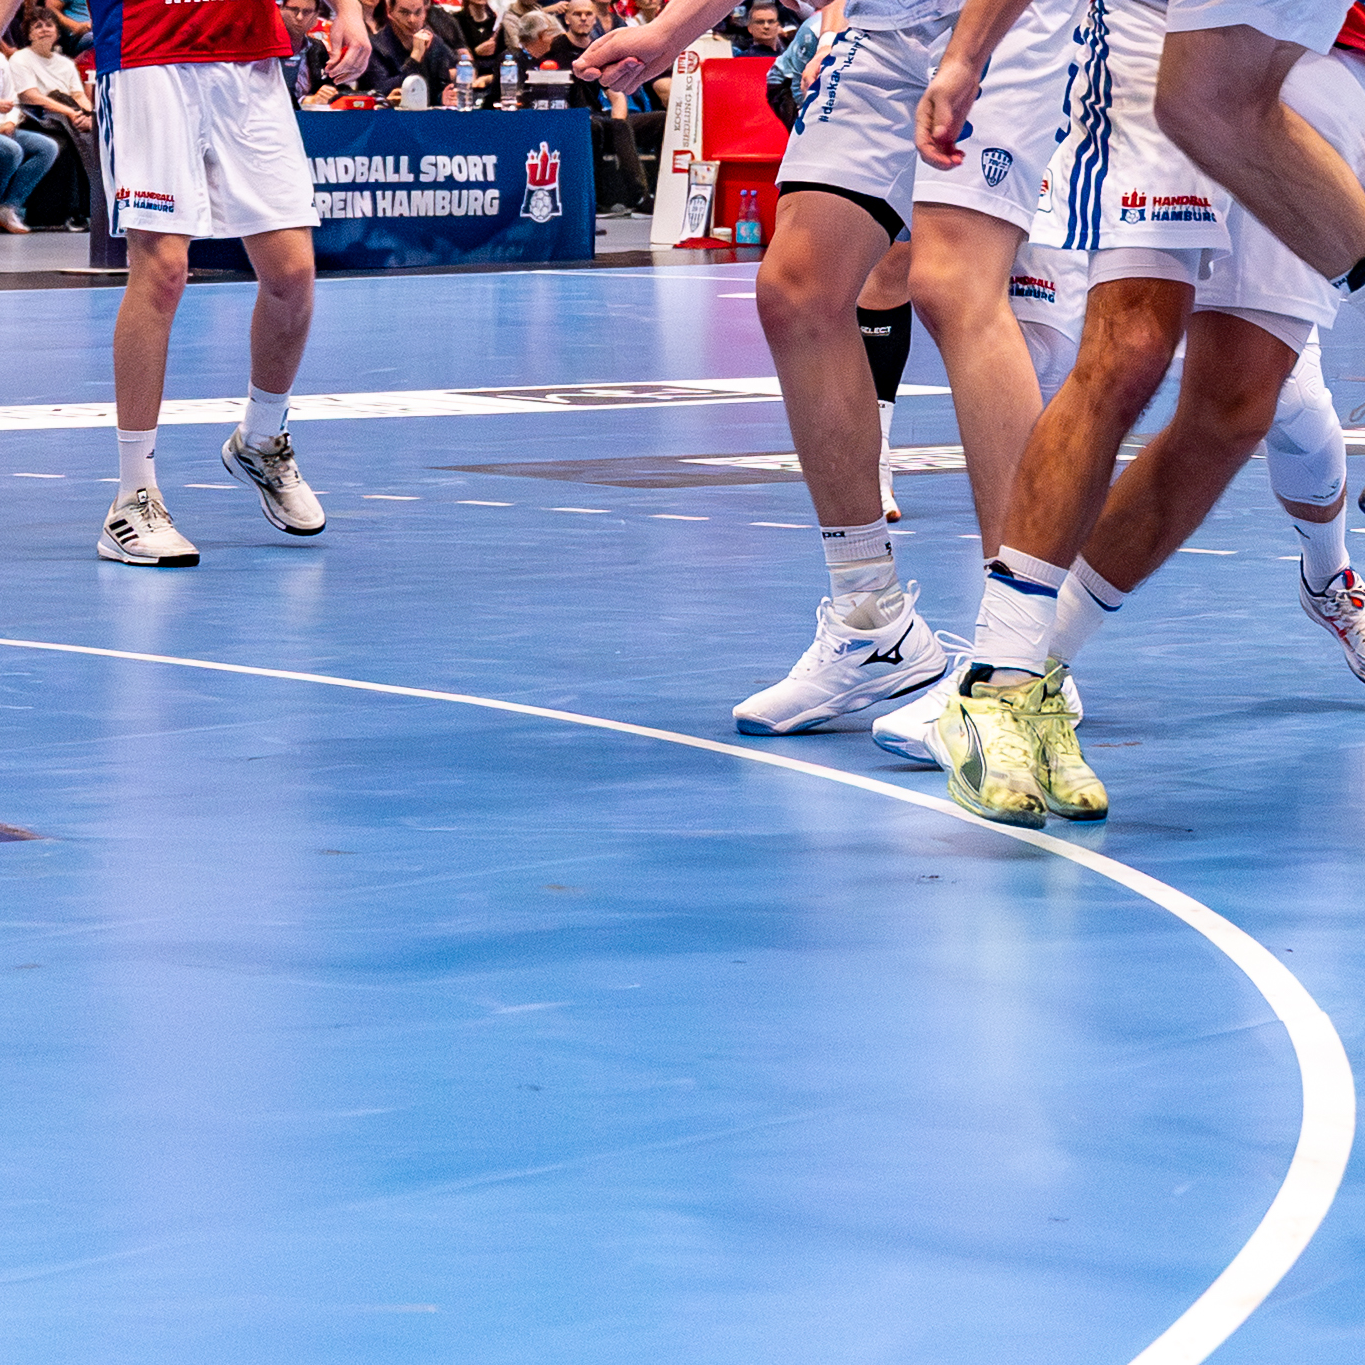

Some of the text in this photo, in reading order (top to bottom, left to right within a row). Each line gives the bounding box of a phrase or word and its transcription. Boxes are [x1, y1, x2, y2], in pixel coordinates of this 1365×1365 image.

[308, 154, 498, 184] ANDBALL SPORT
[313, 189, 500, 219] REIN HAMBURG
